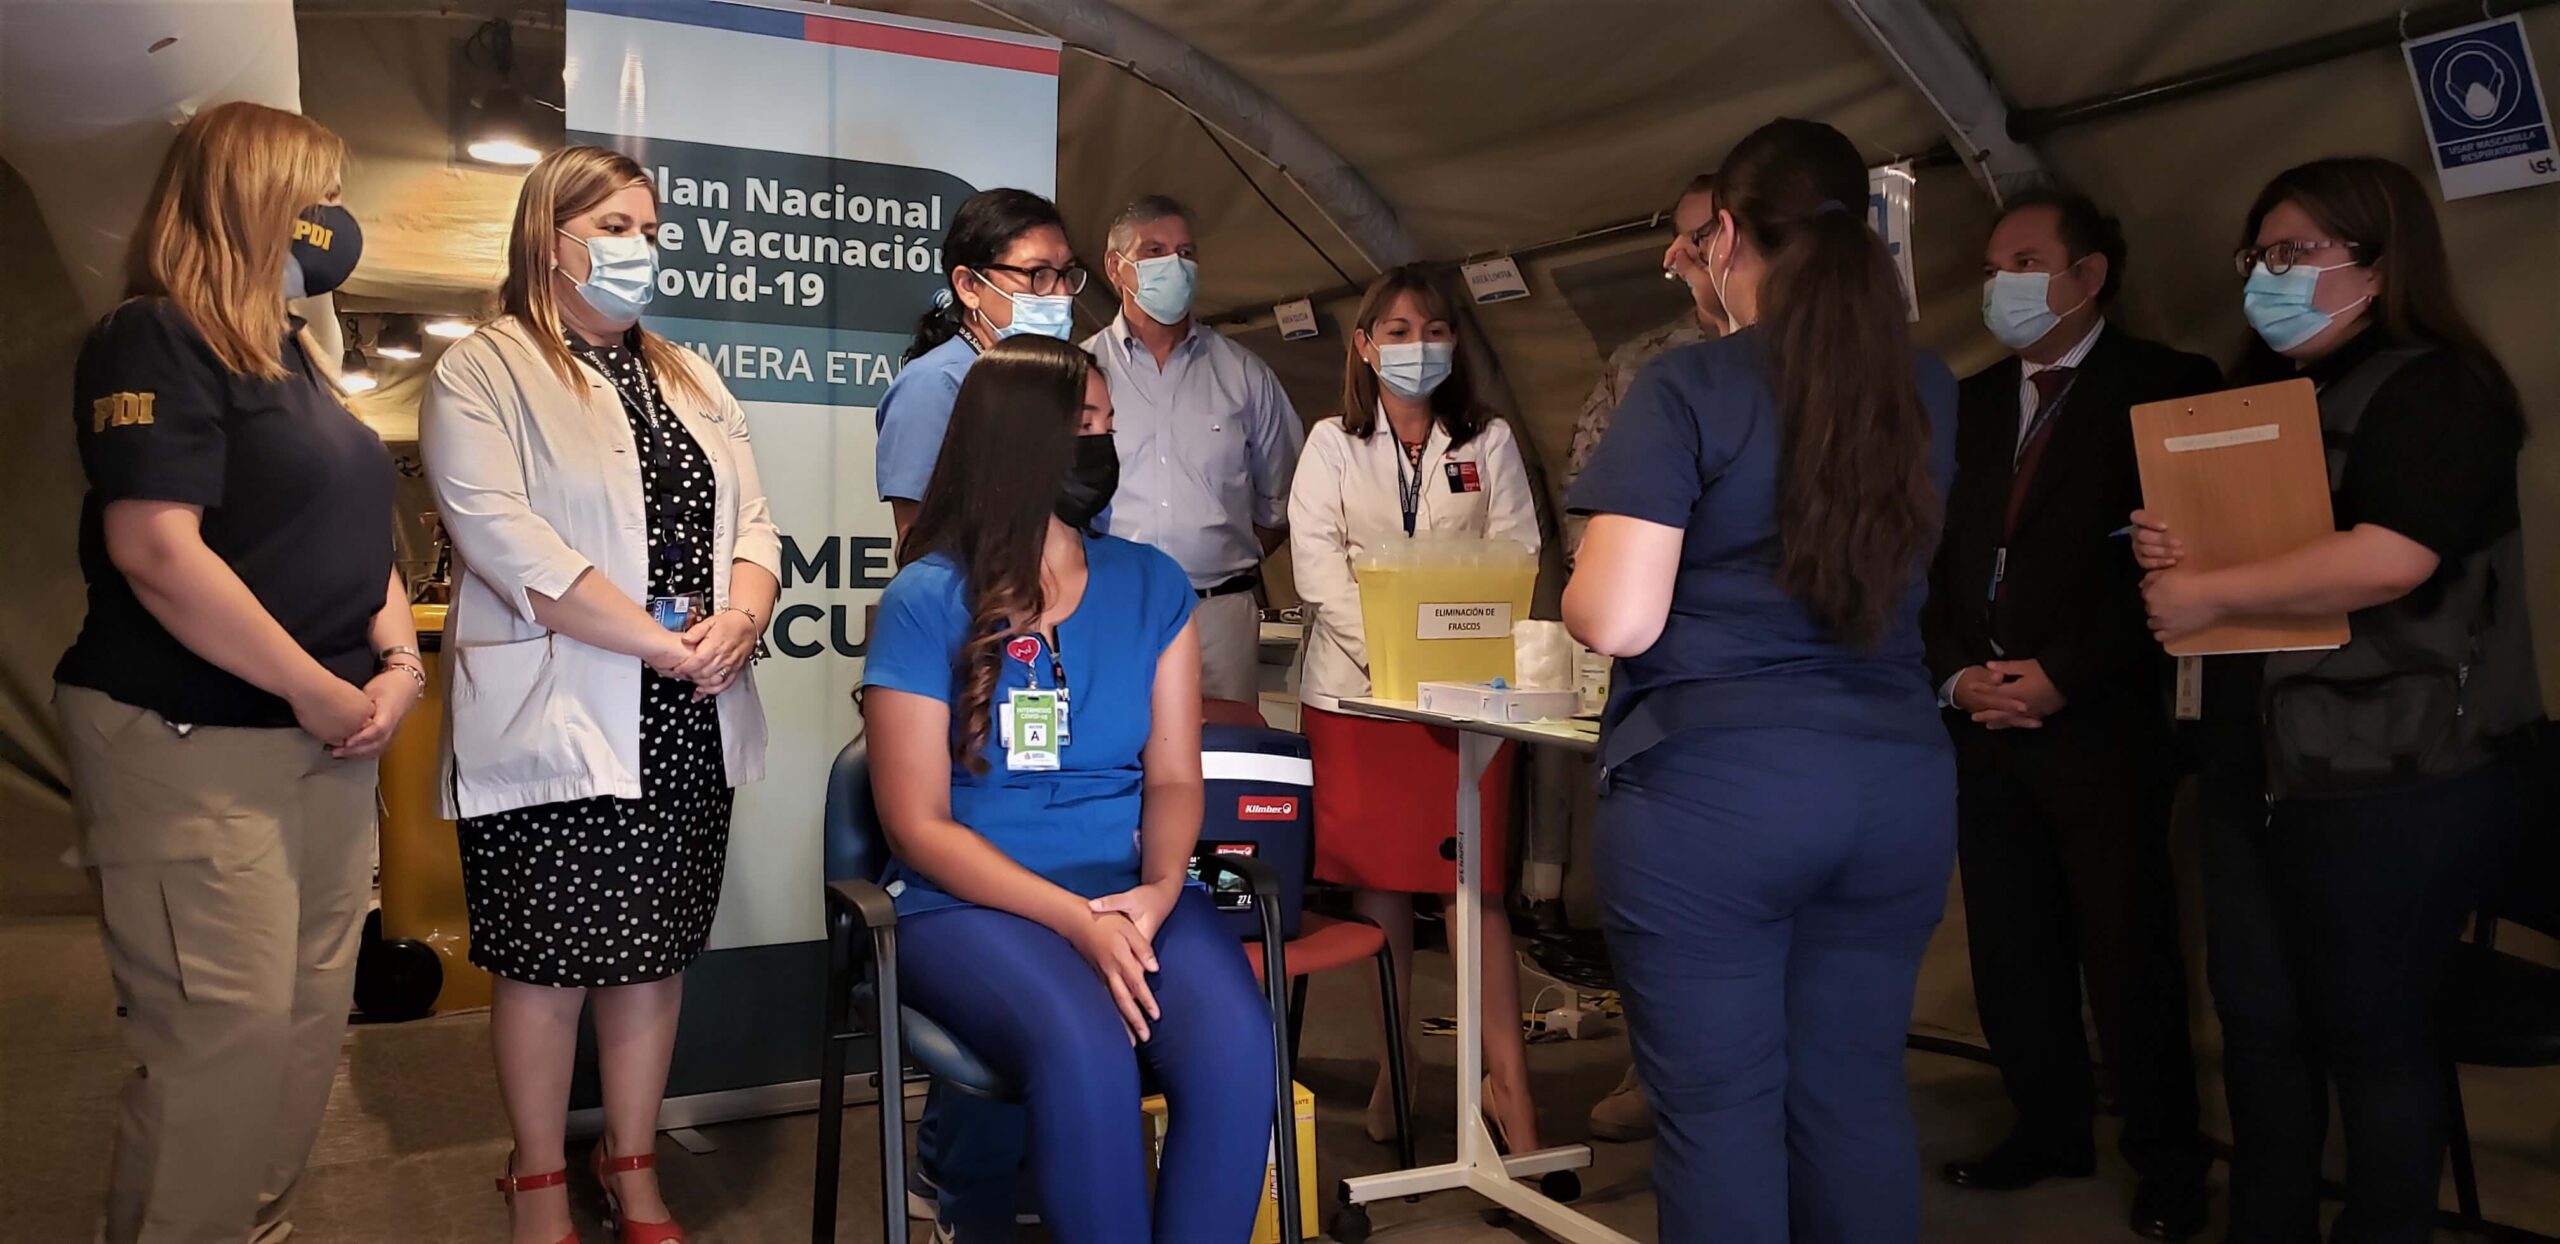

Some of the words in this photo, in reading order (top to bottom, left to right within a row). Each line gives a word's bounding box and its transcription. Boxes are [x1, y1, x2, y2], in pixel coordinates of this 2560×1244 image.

[2449, 143, 2475, 154] USAR
[2476, 131, 2536, 149] MASCARILLA
[2461, 144, 2528, 161] RESPIRATORIA
[745, 177, 942, 231] Nacional
[293, 219, 334, 251] PDI
[656, 222, 684, 251] e
[657, 262, 826, 307] ovid-19
[587, 350, 612, 377] Servicio
[684, 340, 815, 383] MERA
[826, 350, 904, 386] ETA
[93, 391, 156, 433] PDI
[645, 400, 660, 428] Servicio
[1434, 606, 1484, 617] ELIMINACIÓN
[1485, 607, 1496, 617] DE
[1447, 622, 1481, 631] FRASCOS
[1030, 730, 1040, 742] A
[1236, 894, 1247, 904] 27
